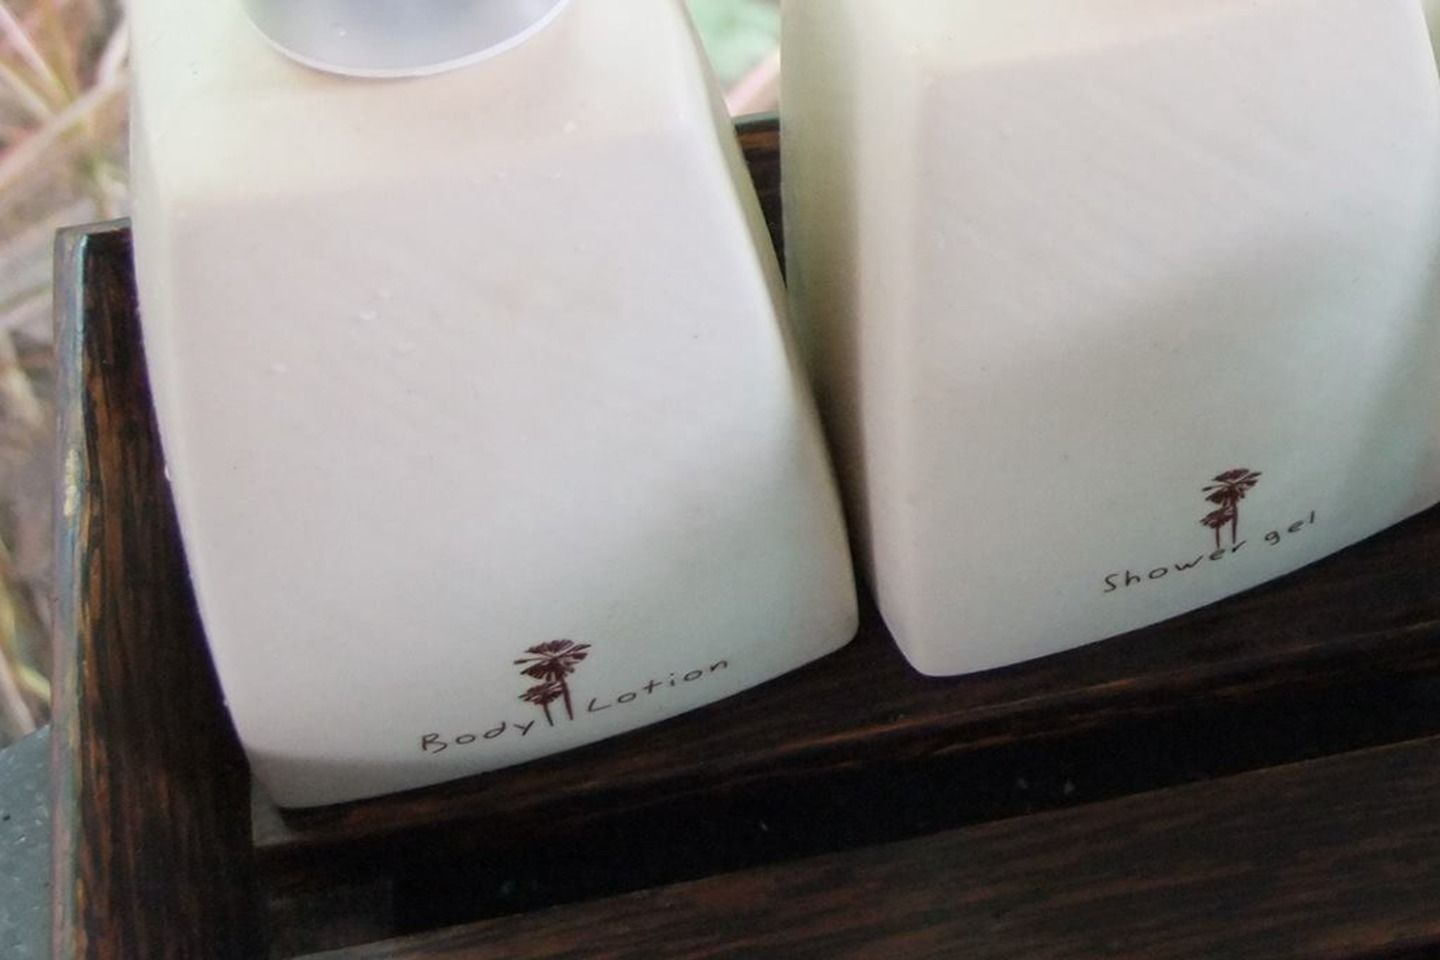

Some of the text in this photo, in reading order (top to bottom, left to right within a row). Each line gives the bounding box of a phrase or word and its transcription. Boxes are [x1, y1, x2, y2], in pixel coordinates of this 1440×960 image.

[1103, 510, 1316, 593] Shower gel
[420, 658, 729, 754] Body Lotion
